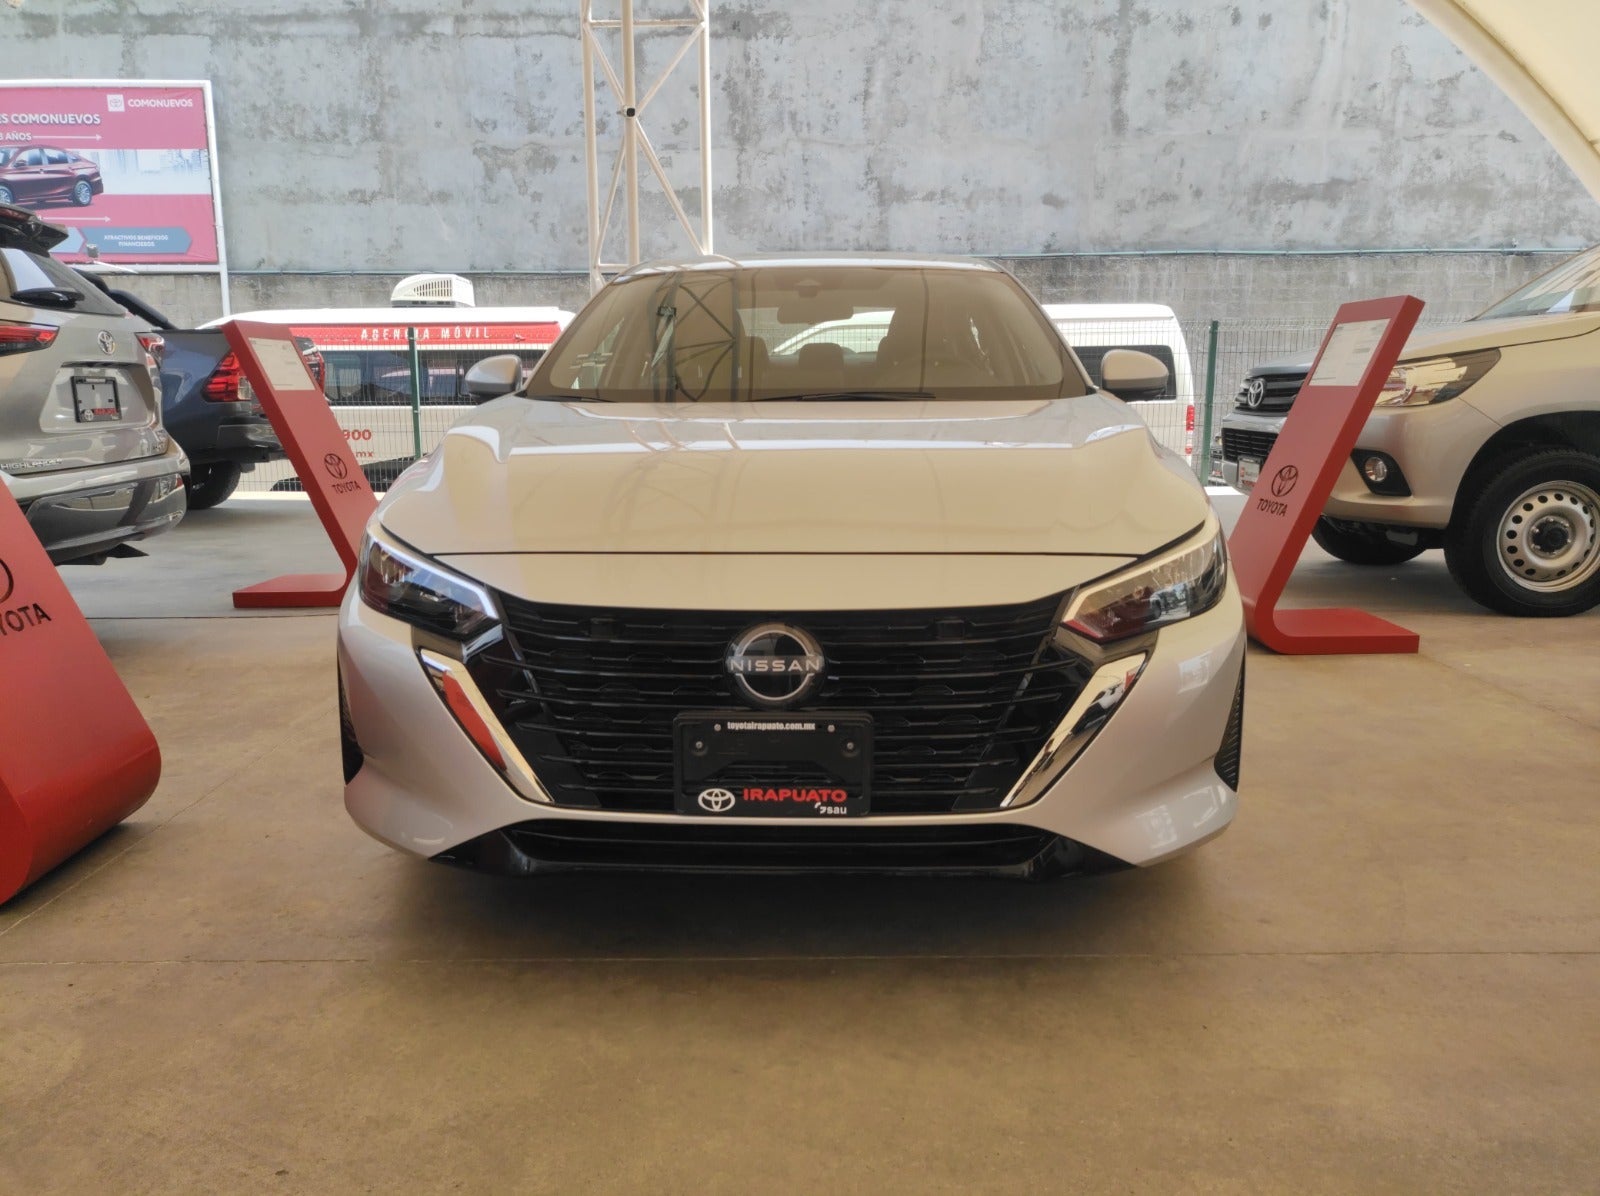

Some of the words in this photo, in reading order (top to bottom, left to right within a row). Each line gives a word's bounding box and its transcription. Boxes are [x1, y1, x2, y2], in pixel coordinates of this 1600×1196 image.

[128, 98, 193, 108] COMONUEVOS
[10, 113, 101, 124] COMONUEVOS
[5, 131, 32, 141] AÑOS
[441, 326, 490, 339] MÓVIL
[332, 481, 361, 493] TOYOTA
[1257, 498, 1288, 516] TOYOTA
[730, 660, 820, 672] NISSAN
[727, 721, 816, 731] toyotairapuato.com.mx
[743, 788, 848, 803] IRAPUATO
